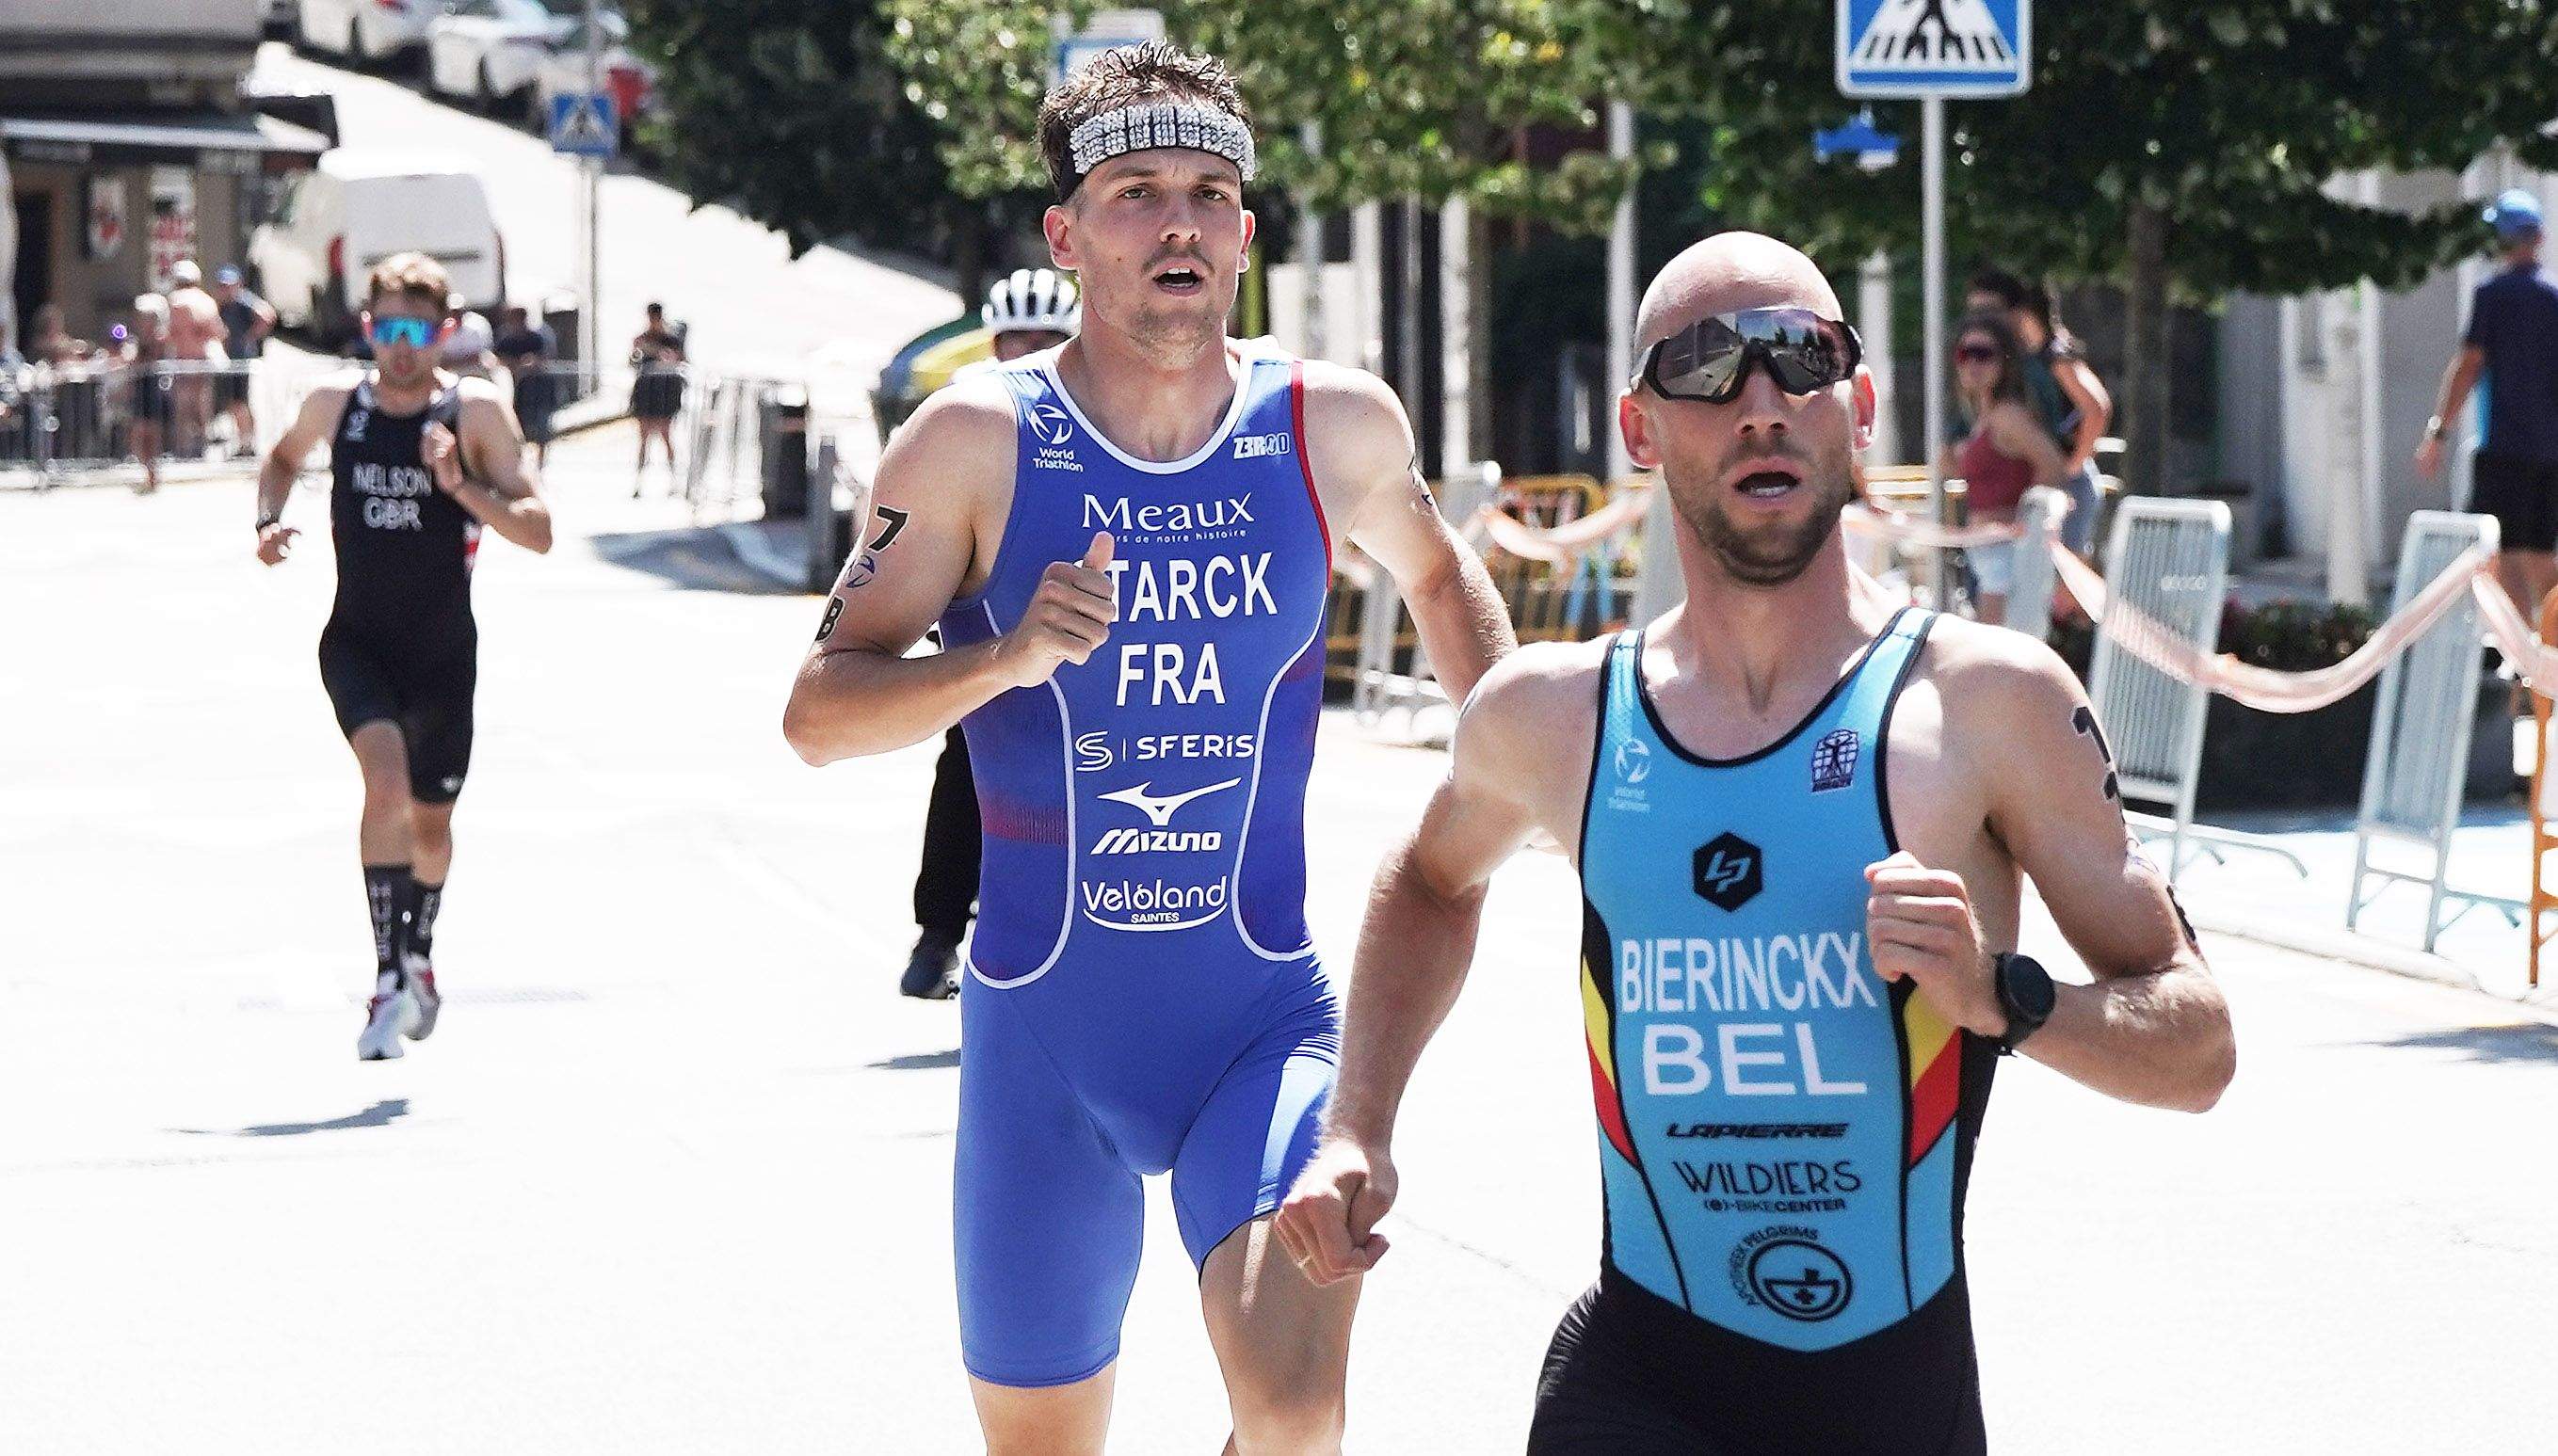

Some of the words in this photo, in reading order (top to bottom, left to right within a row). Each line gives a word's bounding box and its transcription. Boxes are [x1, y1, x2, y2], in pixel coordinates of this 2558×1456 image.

[1032, 457, 1085, 472] Triathlon
[1038, 447, 1075, 460] World
[352, 461, 432, 497] NELSON
[362, 496, 424, 531] GBR
[866, 504, 911, 554] 7
[1082, 491, 1255, 532] Meaux
[1134, 536, 1150, 544] de
[1156, 533, 1190, 543] notre
[1196, 528, 1247, 541] histoire
[1072, 552, 1279, 624] TARCK
[1116, 642, 1226, 706] FRA
[1131, 911, 1181, 924] SAINTES
[1620, 931, 1878, 1015] BIERINCKX
[1642, 1022, 1869, 1096] BEL
[1665, 1122, 1851, 1140] LAPIERRE
[1671, 1160, 1862, 1195] WILDIERS
